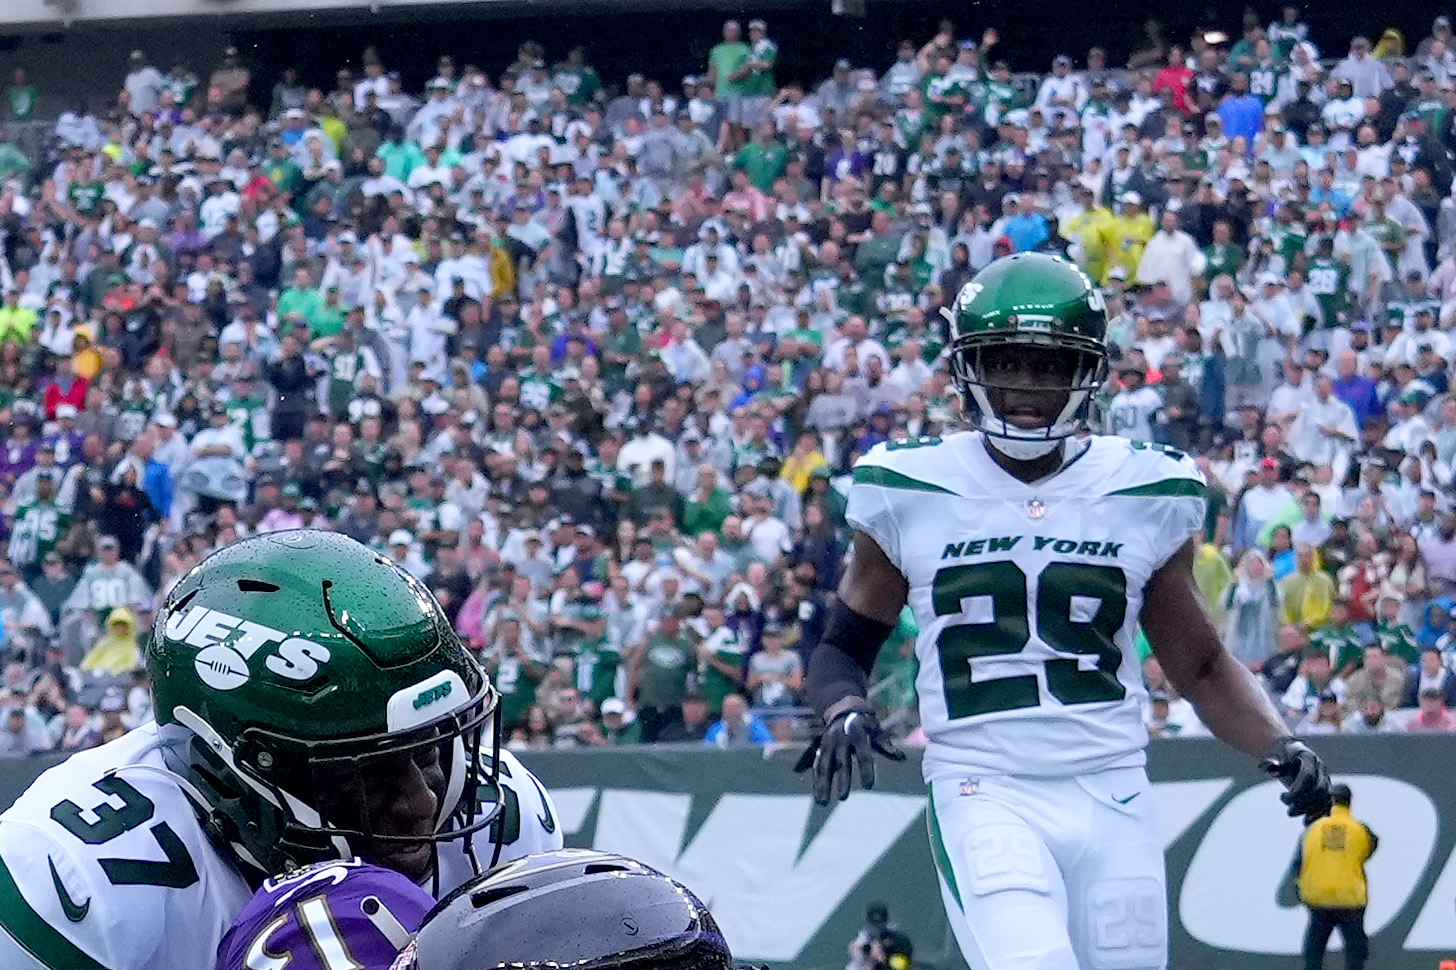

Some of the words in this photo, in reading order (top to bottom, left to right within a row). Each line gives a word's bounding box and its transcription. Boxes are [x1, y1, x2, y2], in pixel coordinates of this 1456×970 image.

[942, 537, 1021, 559] NEW
[1032, 535, 1124, 558] YORK
[166, 606, 331, 681] JETS
[933, 560, 1126, 720] 29
[413, 680, 452, 710] JETS
[48, 774, 200, 889] 37
